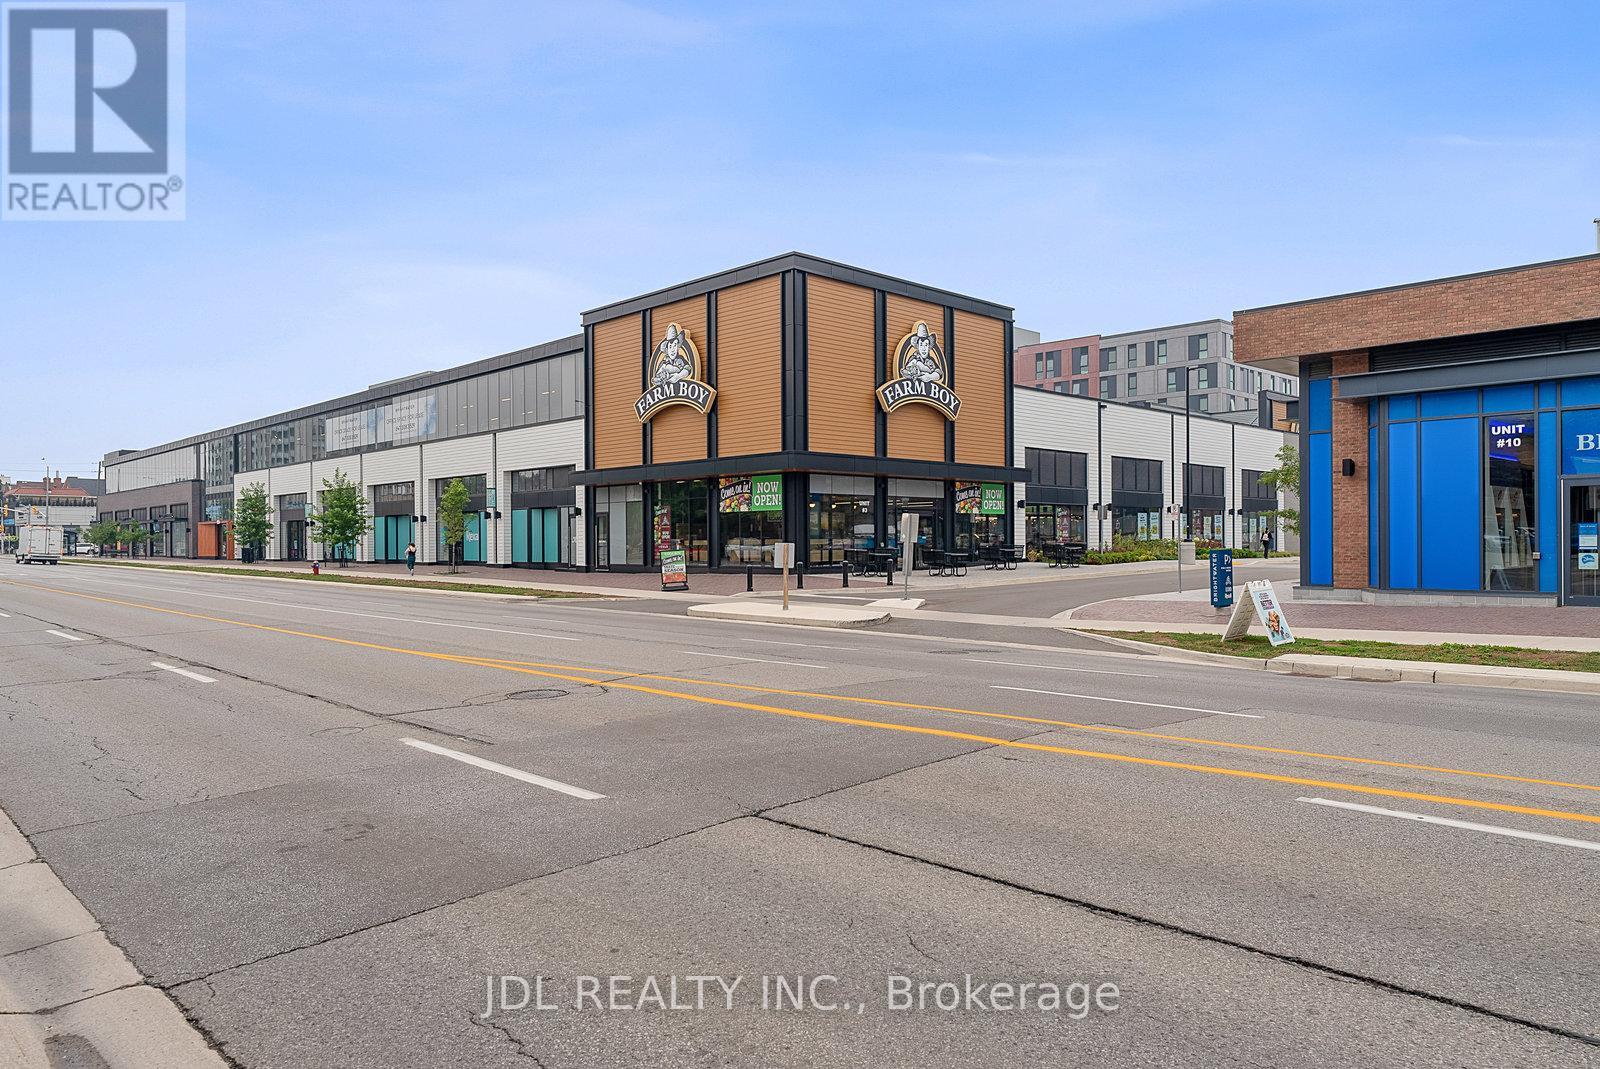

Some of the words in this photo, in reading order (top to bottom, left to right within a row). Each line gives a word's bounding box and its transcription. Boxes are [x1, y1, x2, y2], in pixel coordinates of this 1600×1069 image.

[637, 383, 675, 415] FARM
[678, 381, 709, 404] BOY
[884, 380, 926, 405] FARM
[929, 382, 959, 411] BOY
[1491, 424, 1526, 435] UNIT
[1496, 438, 1521, 448] #10
[720, 486, 735, 499] Come
[735, 484, 742, 494] on
[742, 481, 751, 493] in!
[757, 481, 779, 493] NOW
[754, 494, 781, 506] OPEN!
[985, 489, 1002, 499] NOW
[983, 500, 1004, 510] OPEN!
